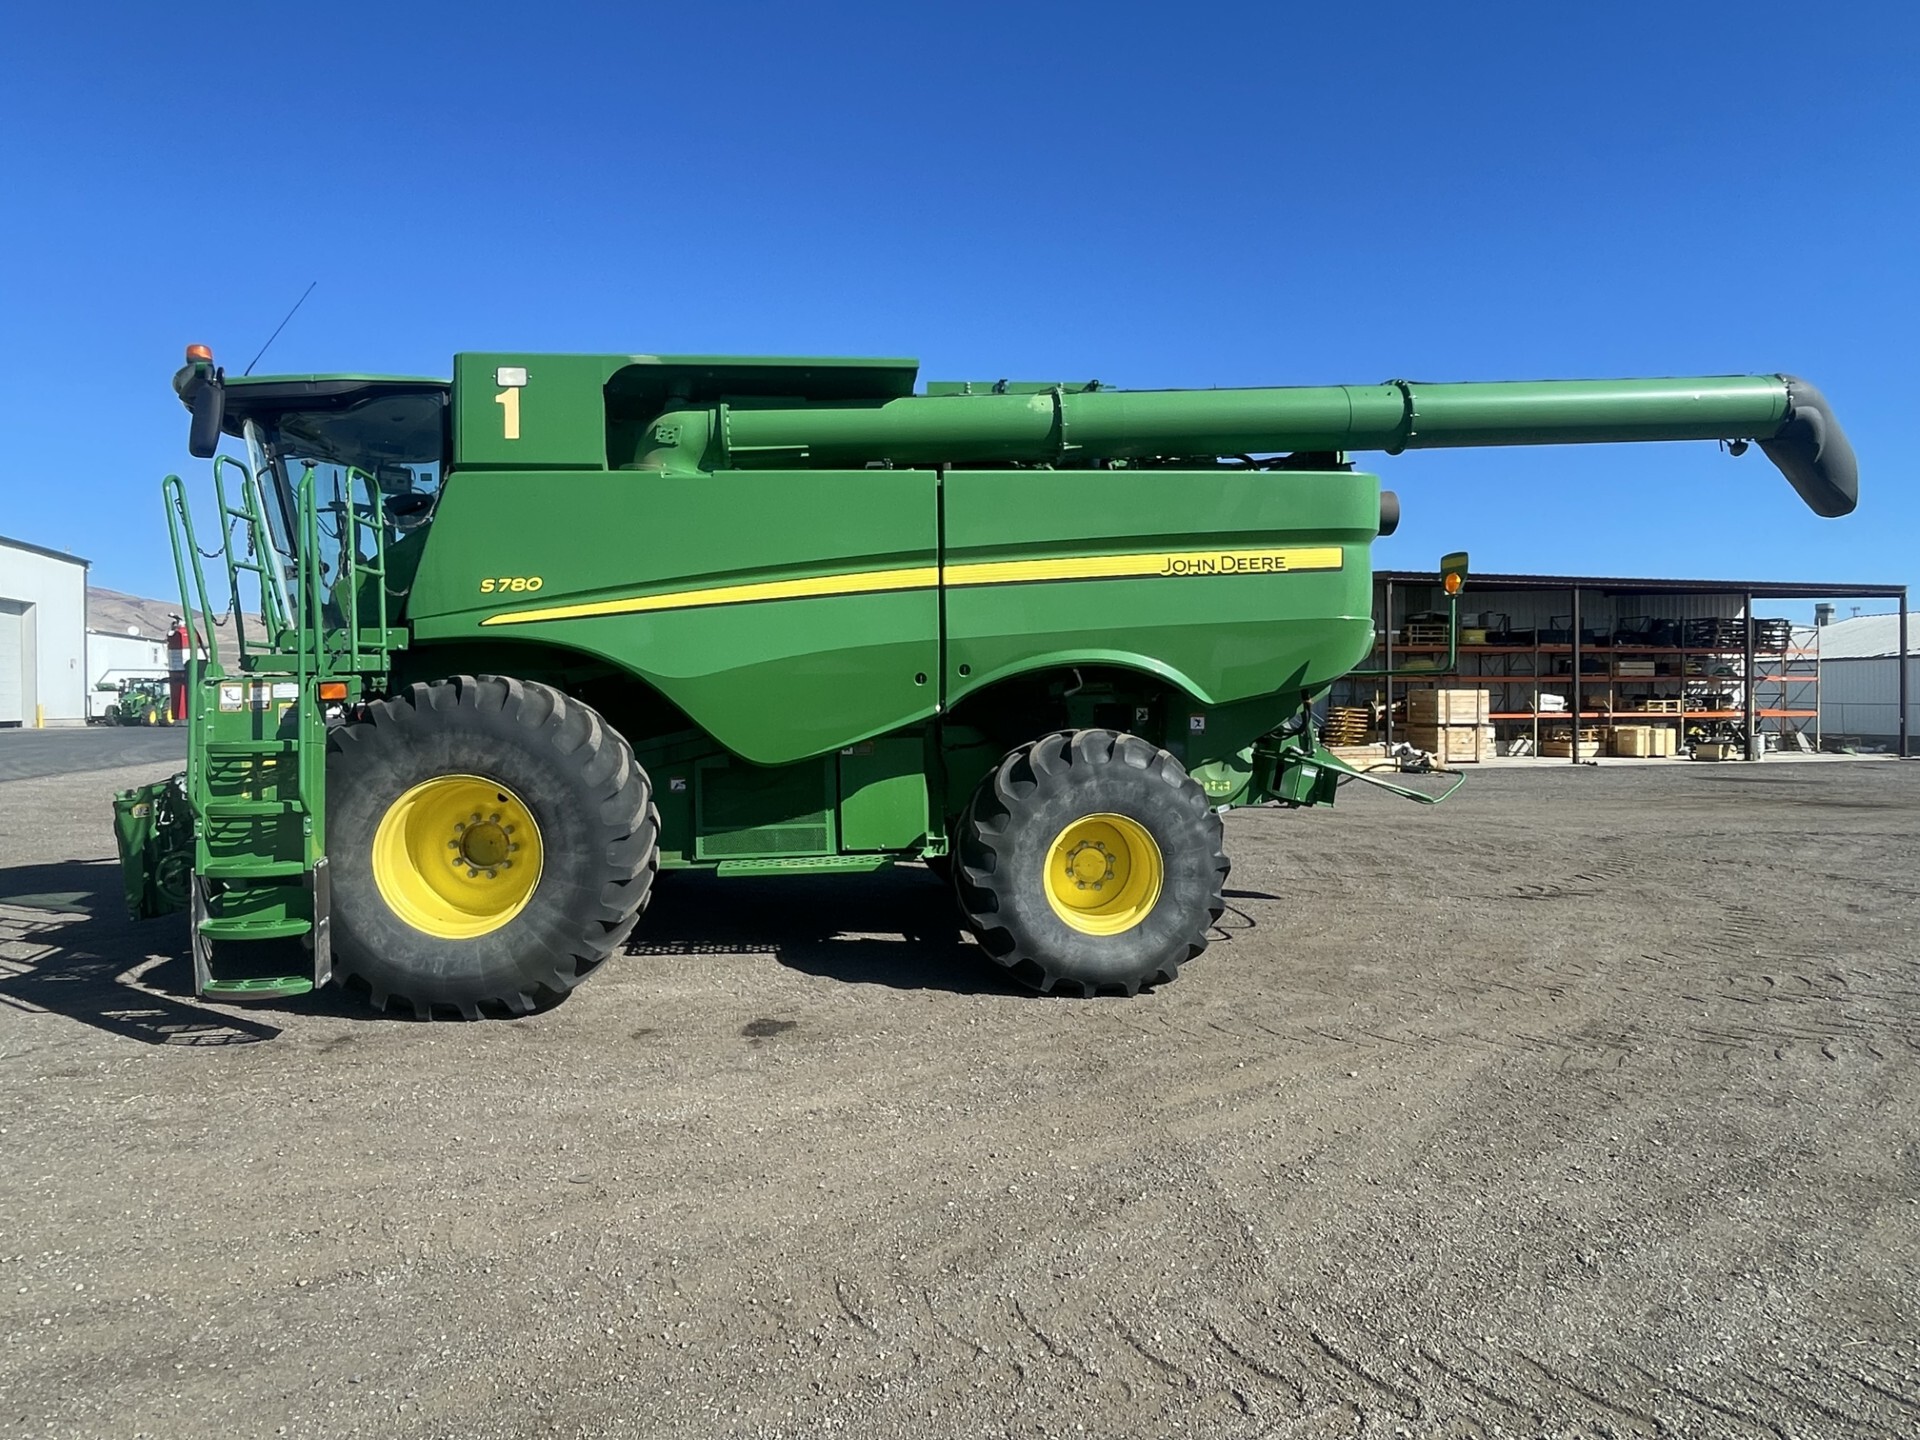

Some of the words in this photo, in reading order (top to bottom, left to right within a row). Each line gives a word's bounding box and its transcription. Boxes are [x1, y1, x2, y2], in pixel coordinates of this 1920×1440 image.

[495, 387, 520, 439] 1
[1161, 557, 1215, 573] JOHN
[1221, 555, 1287, 571] DEERE
